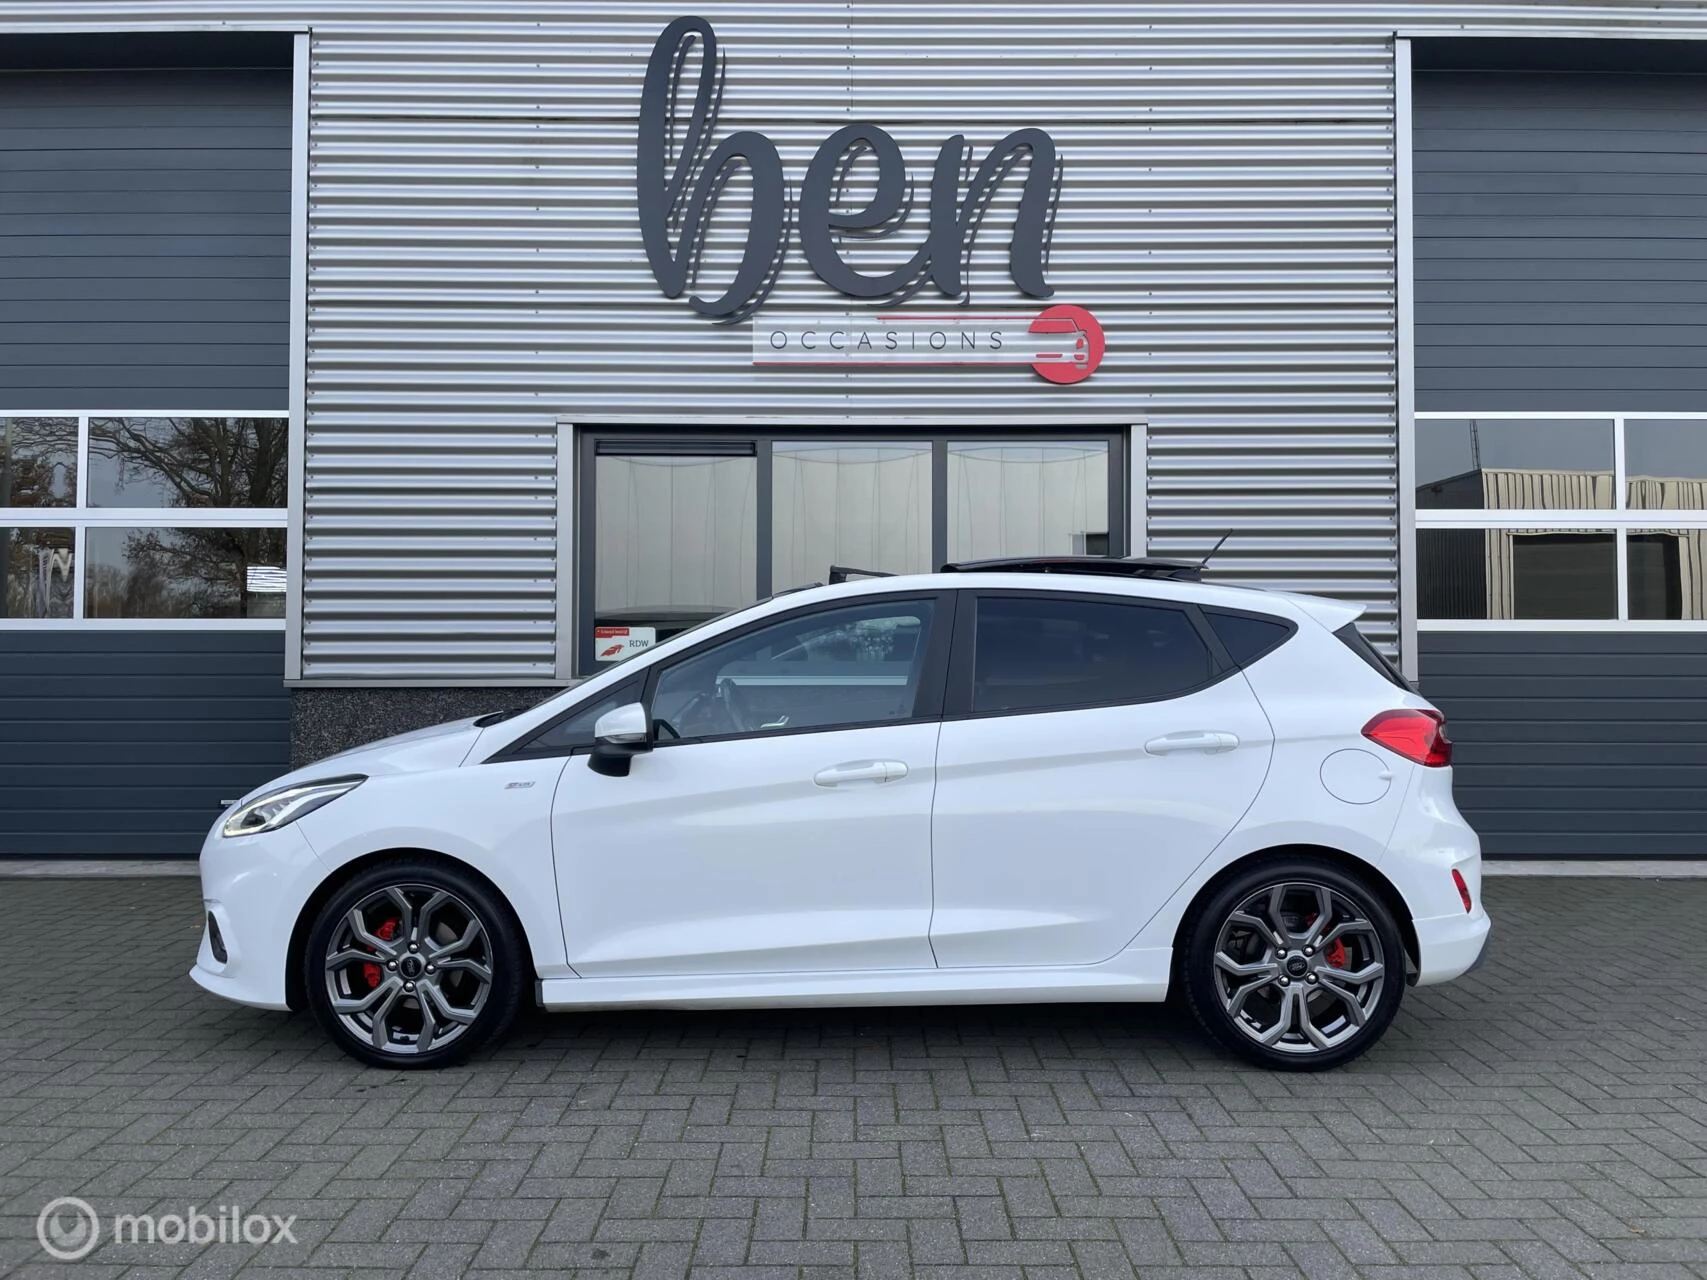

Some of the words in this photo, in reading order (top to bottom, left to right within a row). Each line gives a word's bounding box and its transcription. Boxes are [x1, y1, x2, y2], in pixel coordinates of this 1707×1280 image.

[637, 15, 1056, 316] ben
[770, 330, 1003, 350] OCCASIONS
[629, 639, 649, 648] RDW
